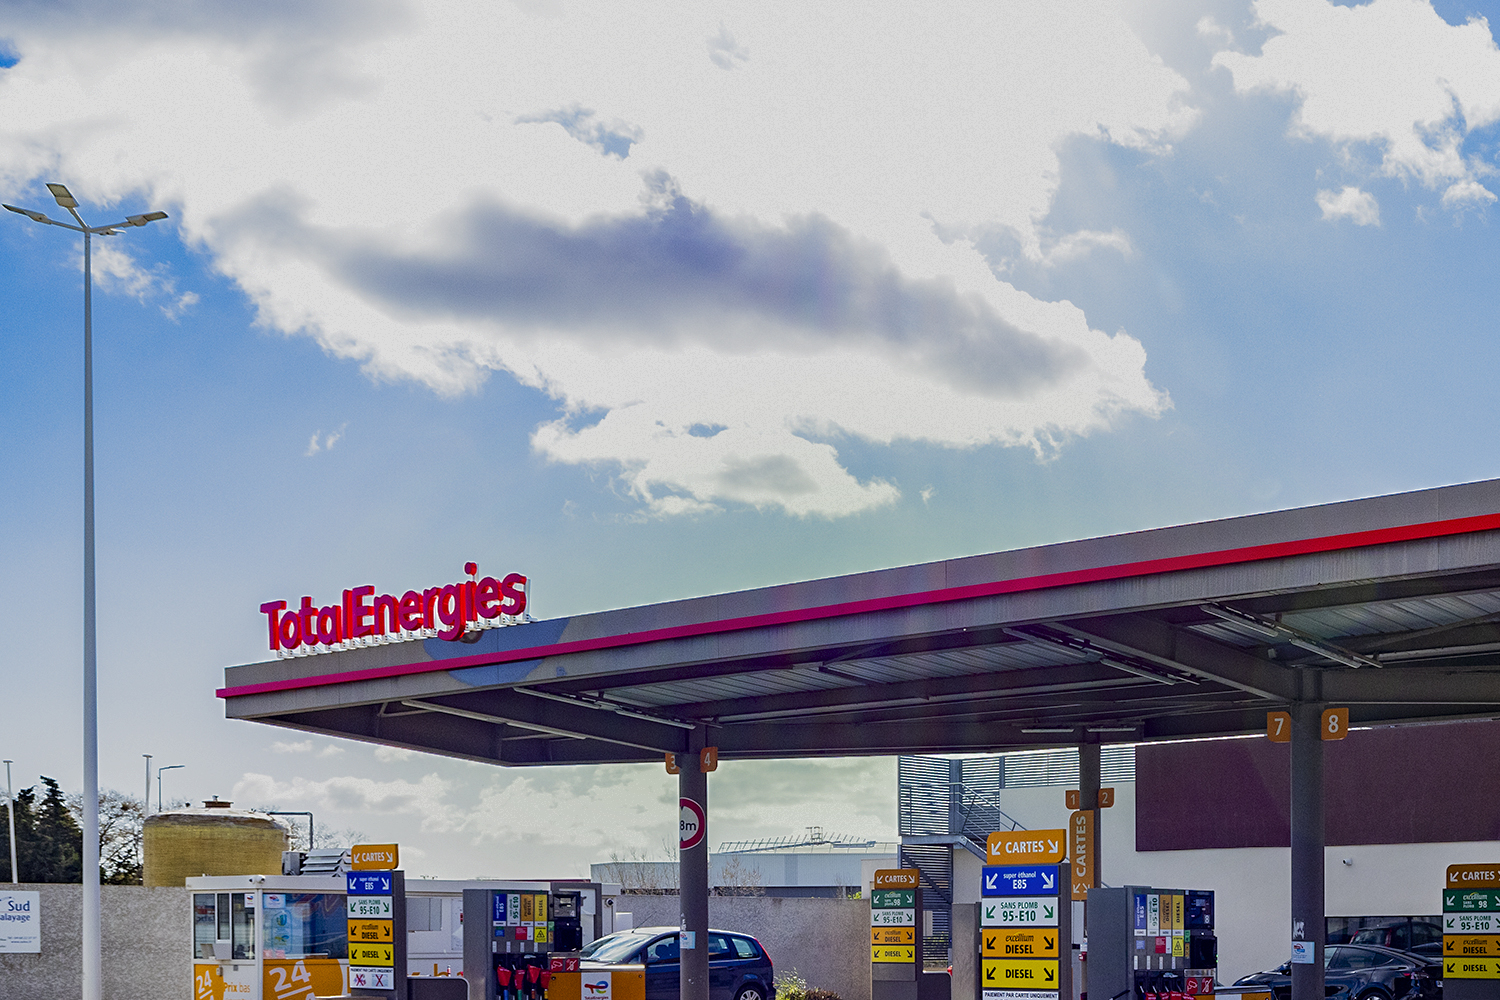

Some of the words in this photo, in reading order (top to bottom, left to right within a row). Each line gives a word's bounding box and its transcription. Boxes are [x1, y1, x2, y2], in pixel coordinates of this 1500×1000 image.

[260, 561, 527, 650] TotalEnergies
[1274, 718, 1284, 736] 7
[1328, 714, 1339, 733] 8
[670, 755, 676, 770] 3
[704, 752, 711, 766] 4
[1071, 794, 1075, 805] 1
[1102, 792, 1108, 804] 2
[1005, 840, 1044, 854] CARTES
[1076, 815, 1086, 877] CARTES
[361, 852, 385, 862] CARTES
[885, 875, 907, 883] CARTES
[1018, 871, 1037, 879] éthanol
[1462, 871, 1495, 880] CARTES
[365, 882, 374, 890] E85
[1012, 879, 1027, 890] E85
[8, 900, 30, 911] Sud
[1018, 901, 1039, 909] PLOMB
[1478, 901, 1488, 909] 98
[359, 906, 380, 915] 95-E10
[883, 916, 903, 924] 95-E10
[1002, 910, 1036, 922] 95-E10
[1461, 922, 1490, 930] 95-E10
[1005, 933, 1034, 942] excellium
[362, 950, 379, 958] DIESEL
[1005, 944, 1034, 954] DIESEL
[269, 960, 311, 992] 24
[1005, 969, 1034, 979] DIESEL
[196, 970, 213, 994] 24
